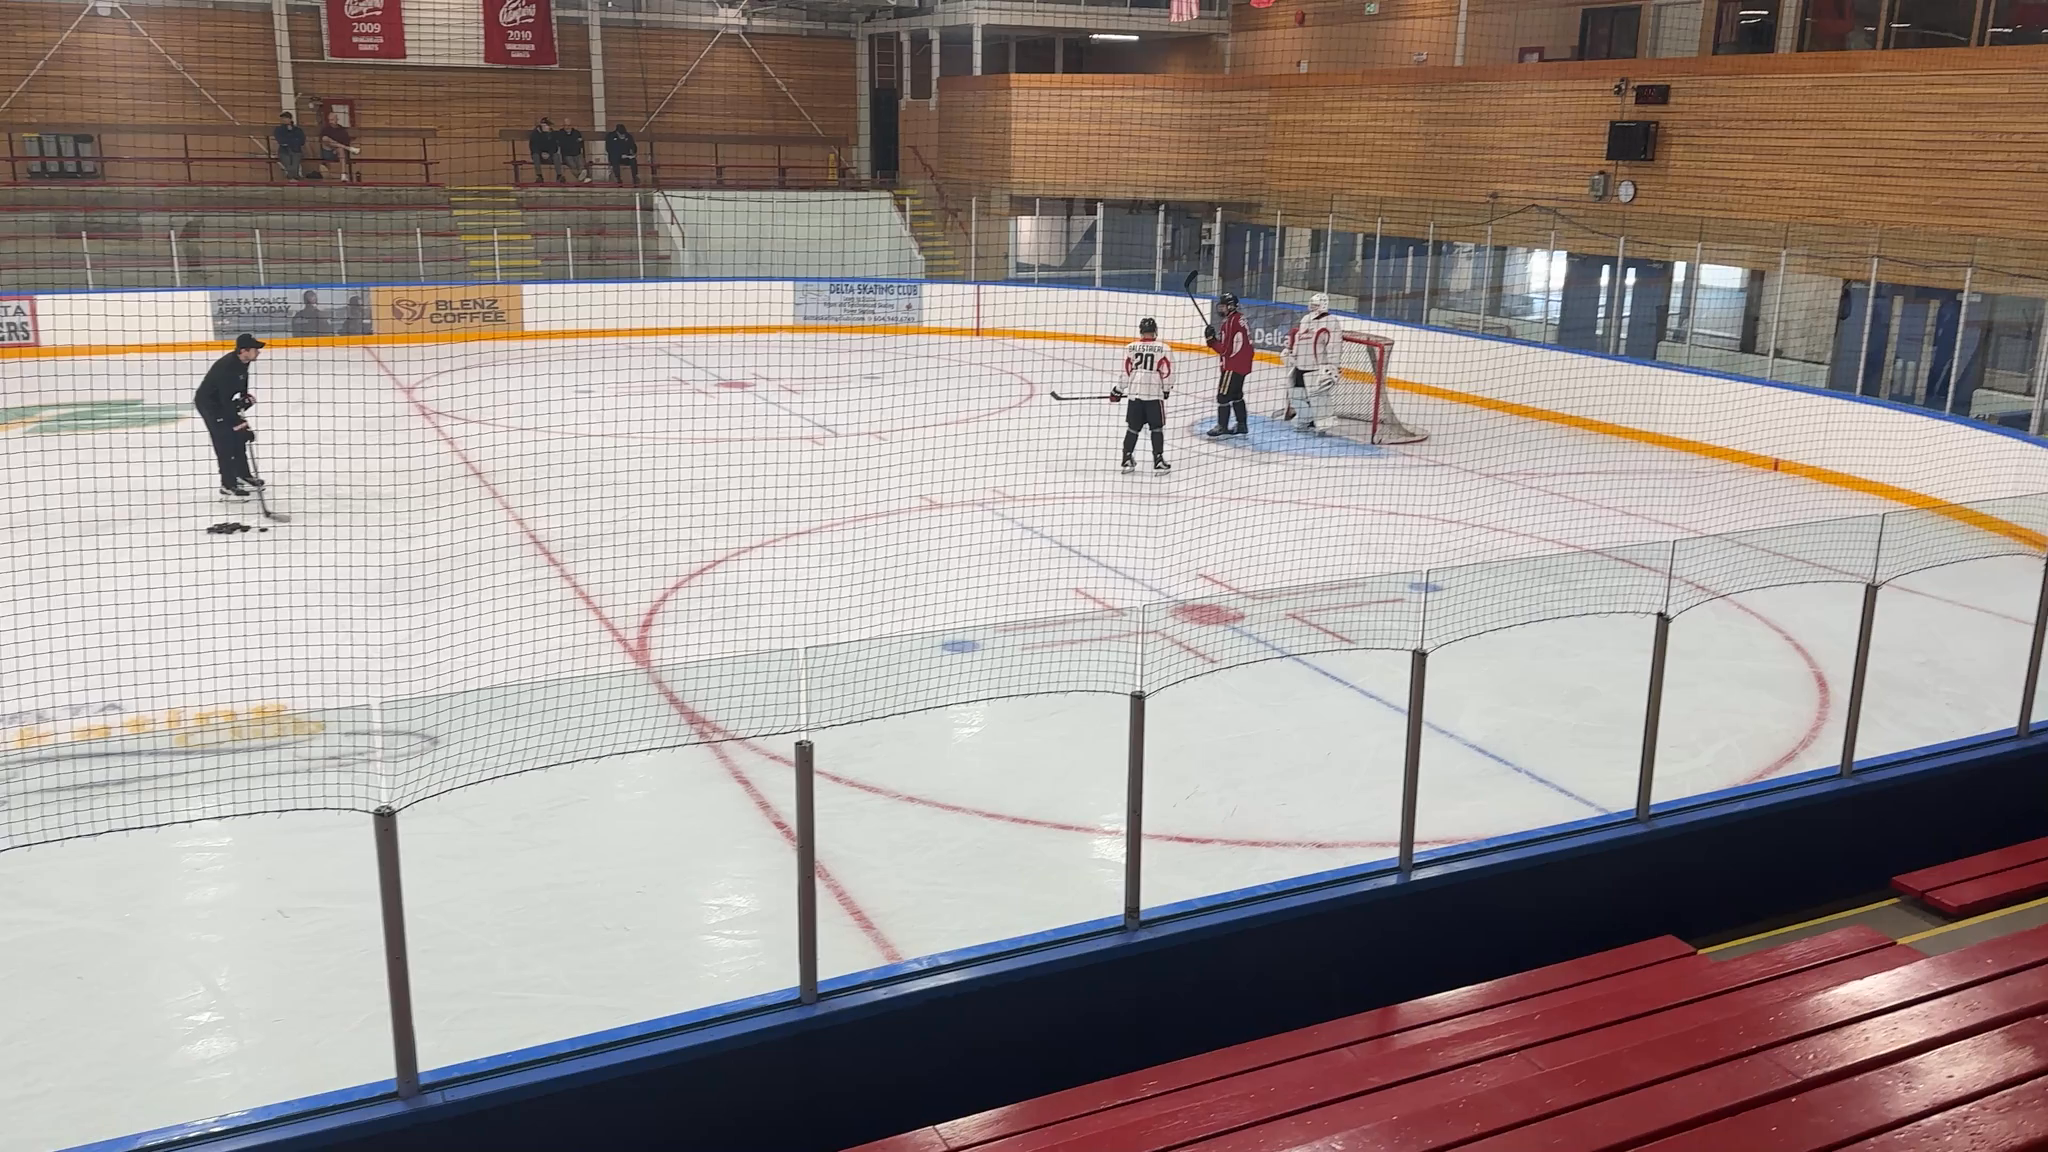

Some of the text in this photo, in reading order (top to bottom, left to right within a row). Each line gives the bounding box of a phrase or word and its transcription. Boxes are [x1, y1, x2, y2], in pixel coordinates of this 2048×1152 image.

[352, 22, 381, 33] 2009
[507, 30, 532, 41] 2010
[829, 283, 918, 296] DELTA SKATING CLUB
[218, 296, 289, 307] DELTA POLICE
[435, 299, 499, 311] BLENZ
[218, 305, 291, 316] APPLY TODAY
[430, 311, 506, 324] COFFEE
[1254, 327, 1289, 348] Delta
[1134, 352, 1155, 372] 20
